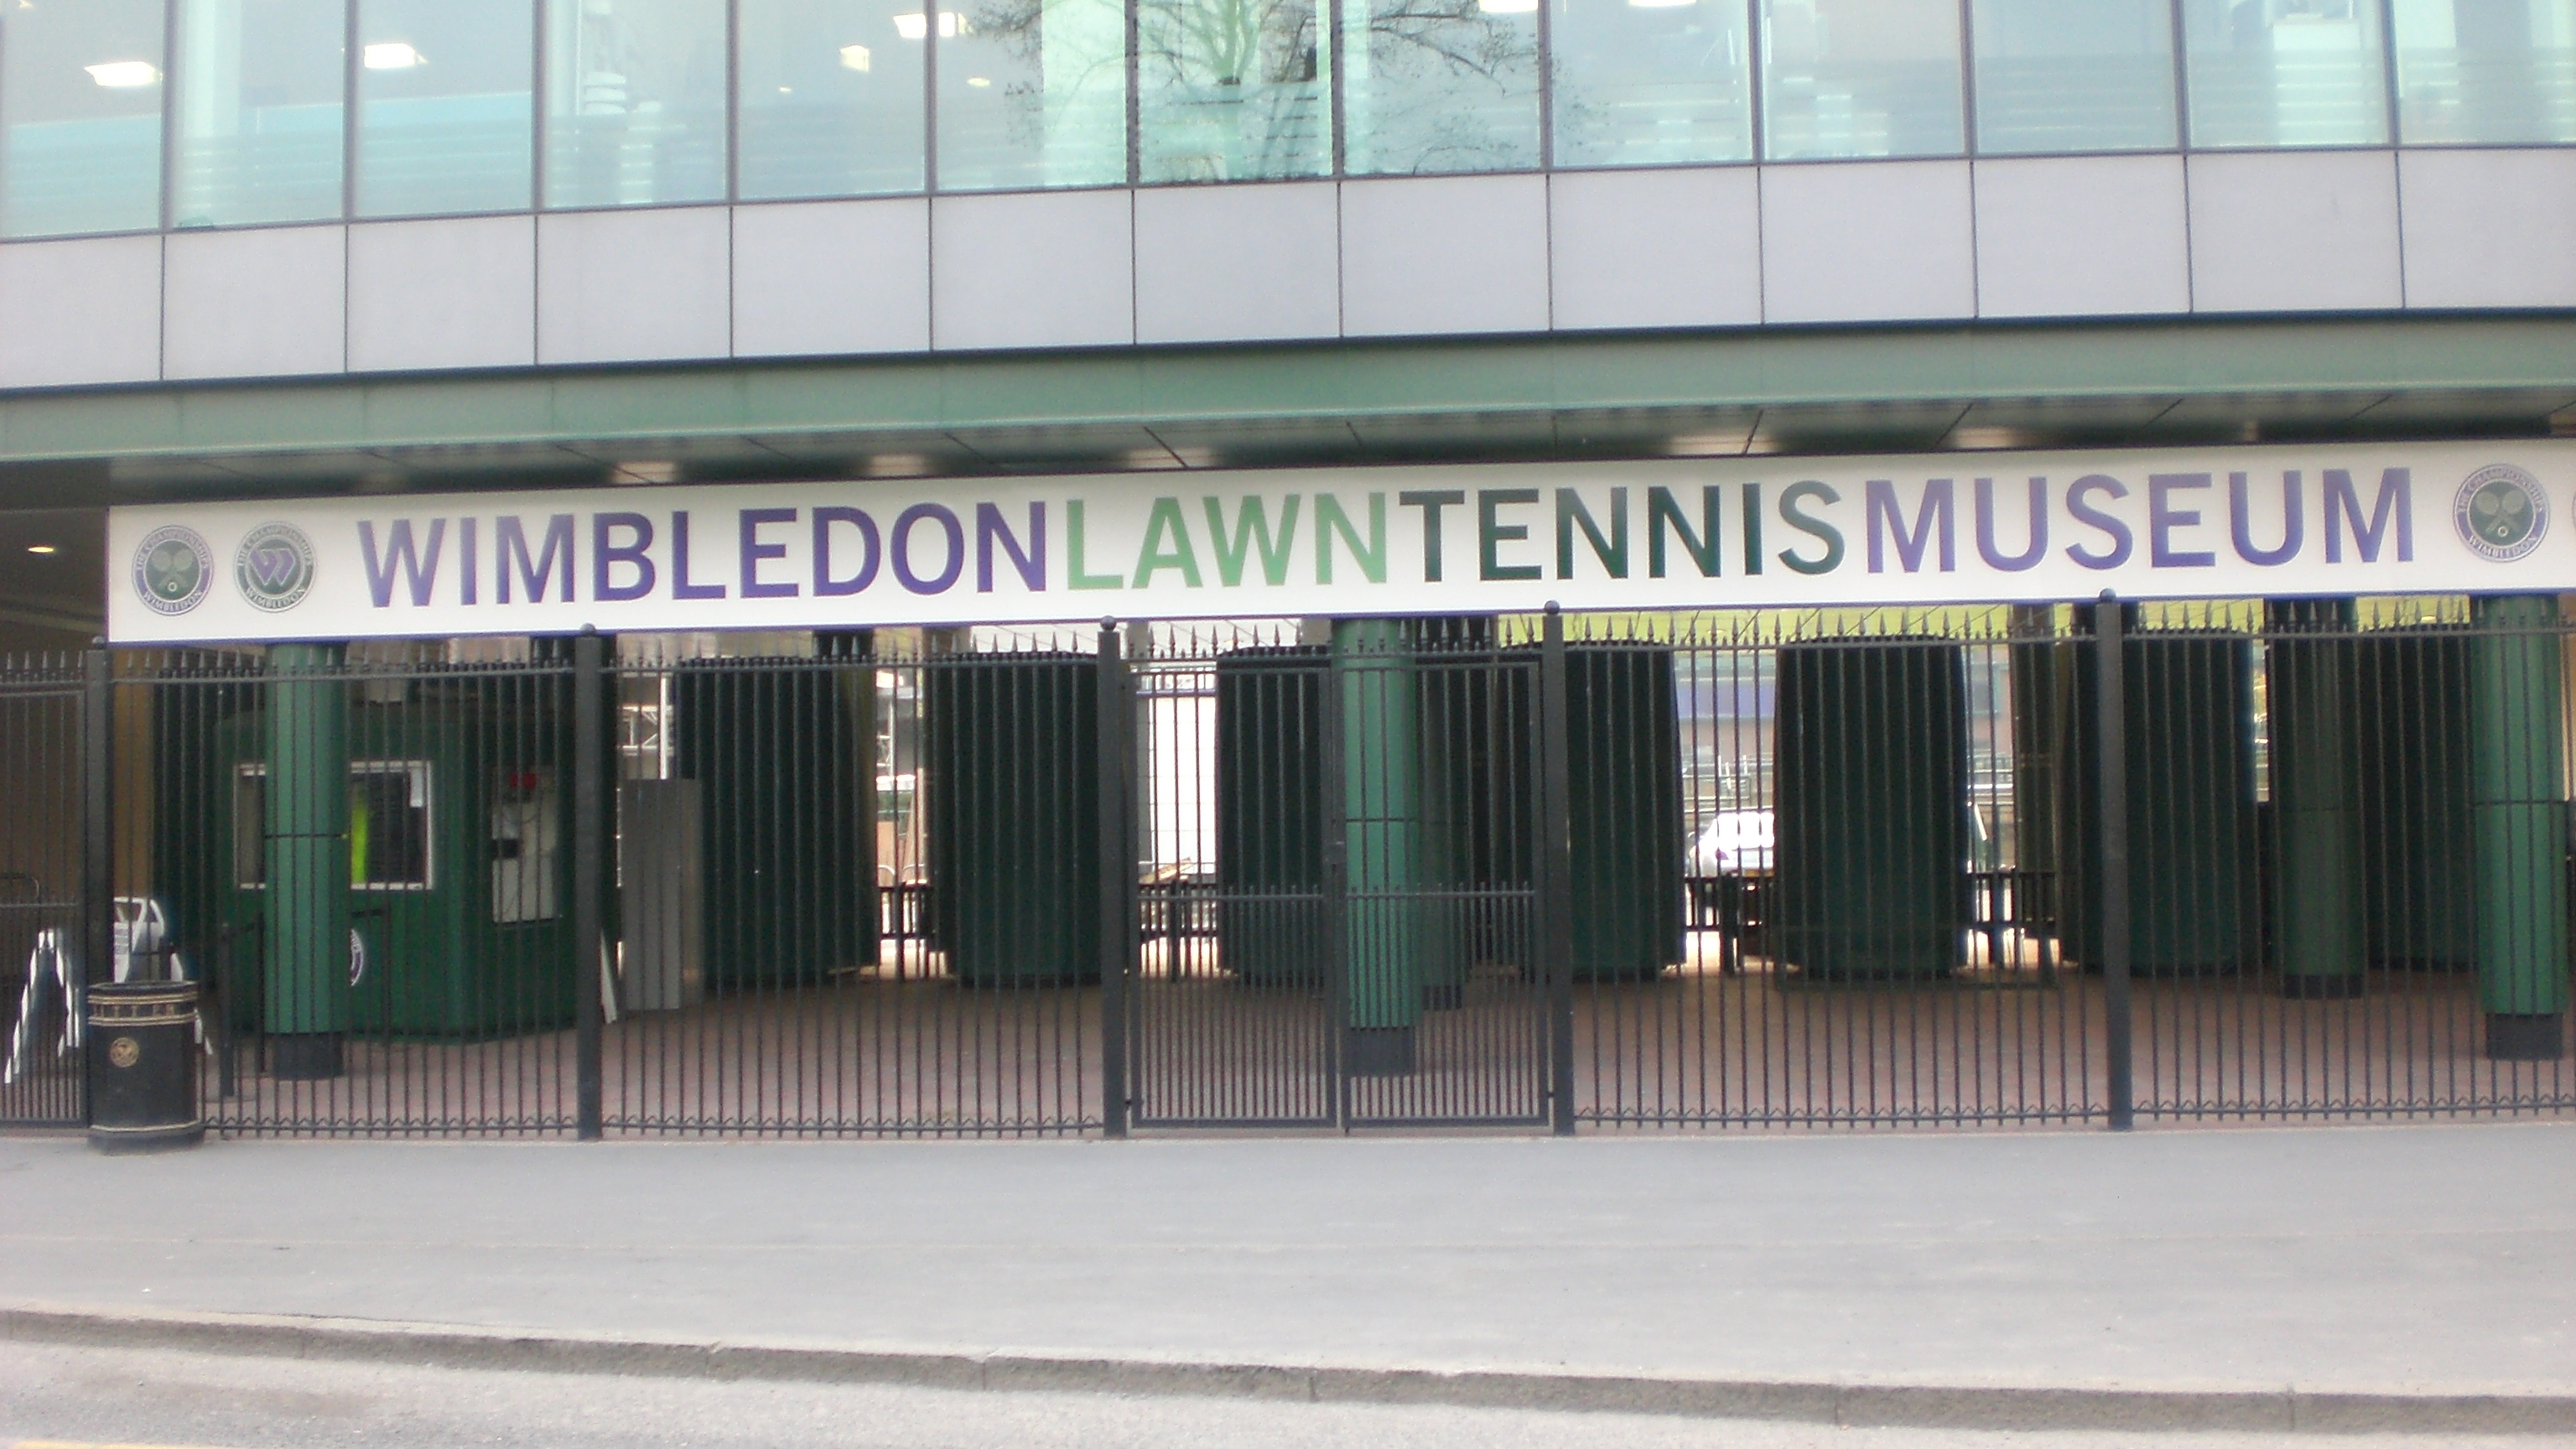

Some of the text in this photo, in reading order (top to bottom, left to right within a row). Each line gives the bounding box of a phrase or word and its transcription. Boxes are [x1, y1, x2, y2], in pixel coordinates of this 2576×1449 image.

[357, 466, 2414, 608] WIMBLEDON LAWN TENNIS MUSEUM
